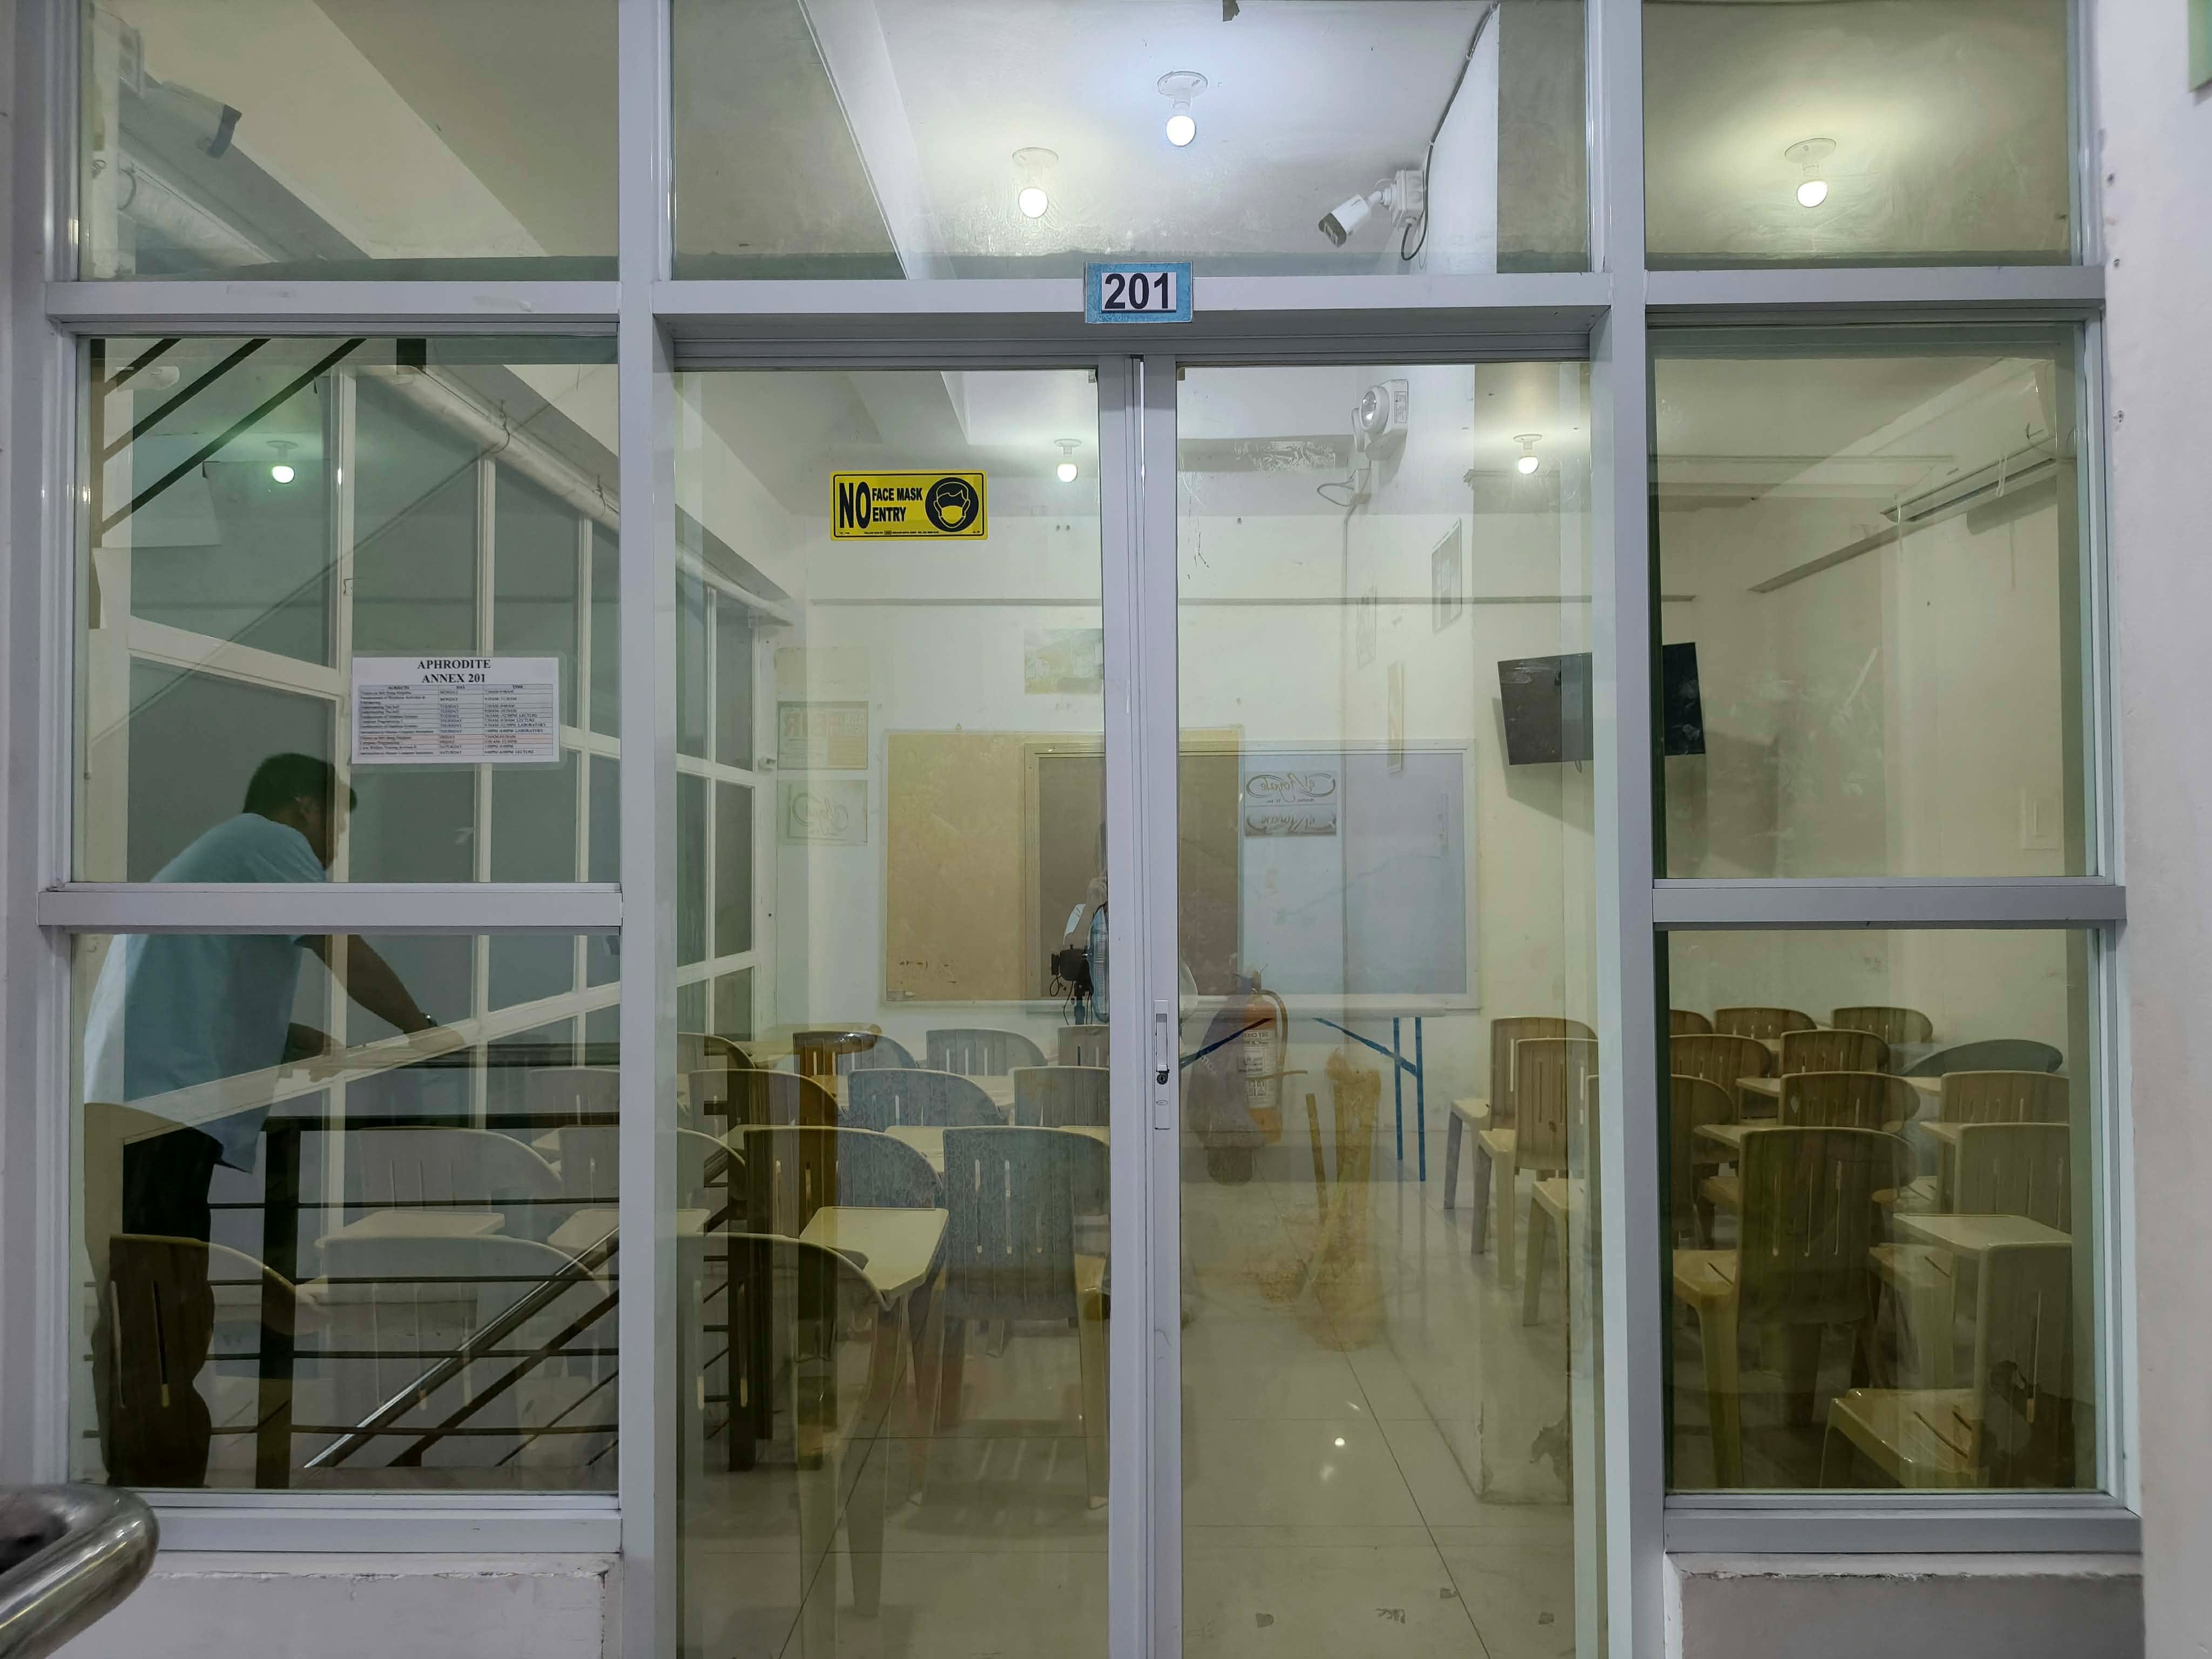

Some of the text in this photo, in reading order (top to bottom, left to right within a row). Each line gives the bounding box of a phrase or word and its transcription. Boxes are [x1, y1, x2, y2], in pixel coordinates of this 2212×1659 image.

[1104, 272, 1169, 309] 201
[872, 488, 923, 501] FACE MASK
[839, 481, 872, 529] NO
[872, 507, 907, 522] ENTRY
[417, 659, 491, 670] APHRODITE
[422, 673, 485, 684] ANNEX 201
